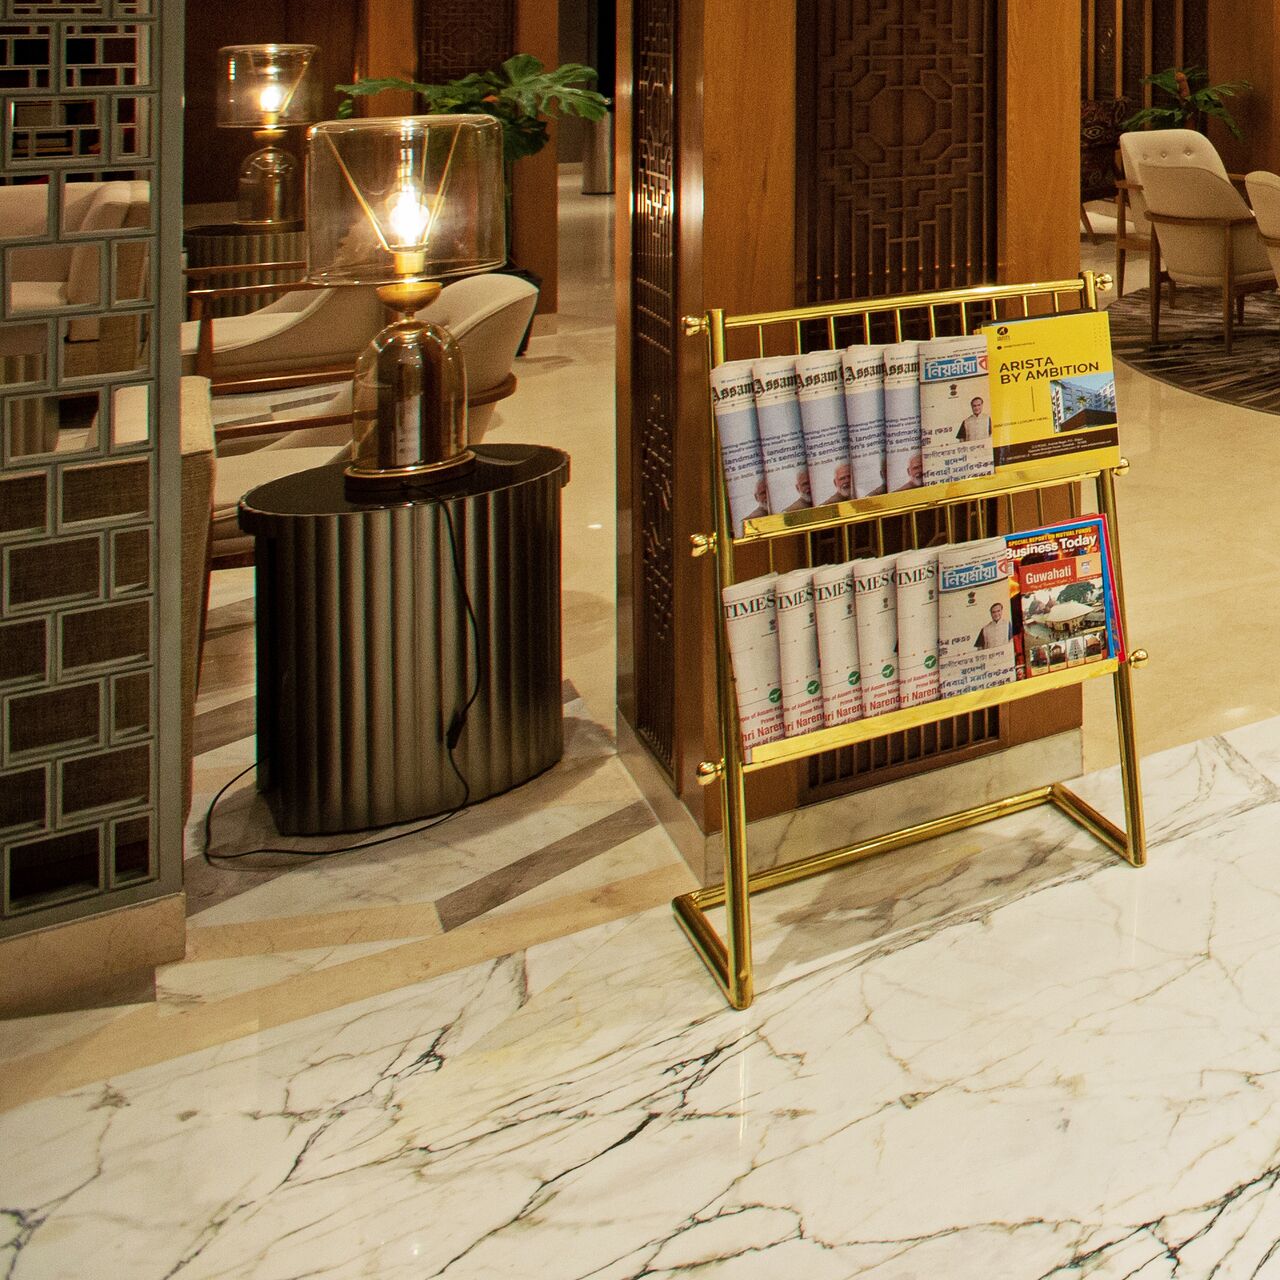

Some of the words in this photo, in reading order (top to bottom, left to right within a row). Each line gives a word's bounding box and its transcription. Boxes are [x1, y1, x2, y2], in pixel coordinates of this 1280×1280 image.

[845, 362, 885, 386] Assam
[1000, 356, 1054, 373] ARISTA
[1000, 372, 1021, 385] BY
[1026, 361, 1100, 381] AMBITION
[754, 374, 797, 397] Assam
[796, 368, 839, 391] Assam
[806, 438, 840, 451] landmark
[1006, 541, 1059, 560] Business
[1059, 534, 1097, 550] Today
[897, 565, 935, 586] IMES
[1025, 565, 1072, 585] Guwahati
[777, 587, 813, 609] IMES
[911, 687, 939, 701] Naren
[796, 713, 824, 728] Naren
[836, 703, 862, 718] Naren
[757, 721, 785, 737] Naren
